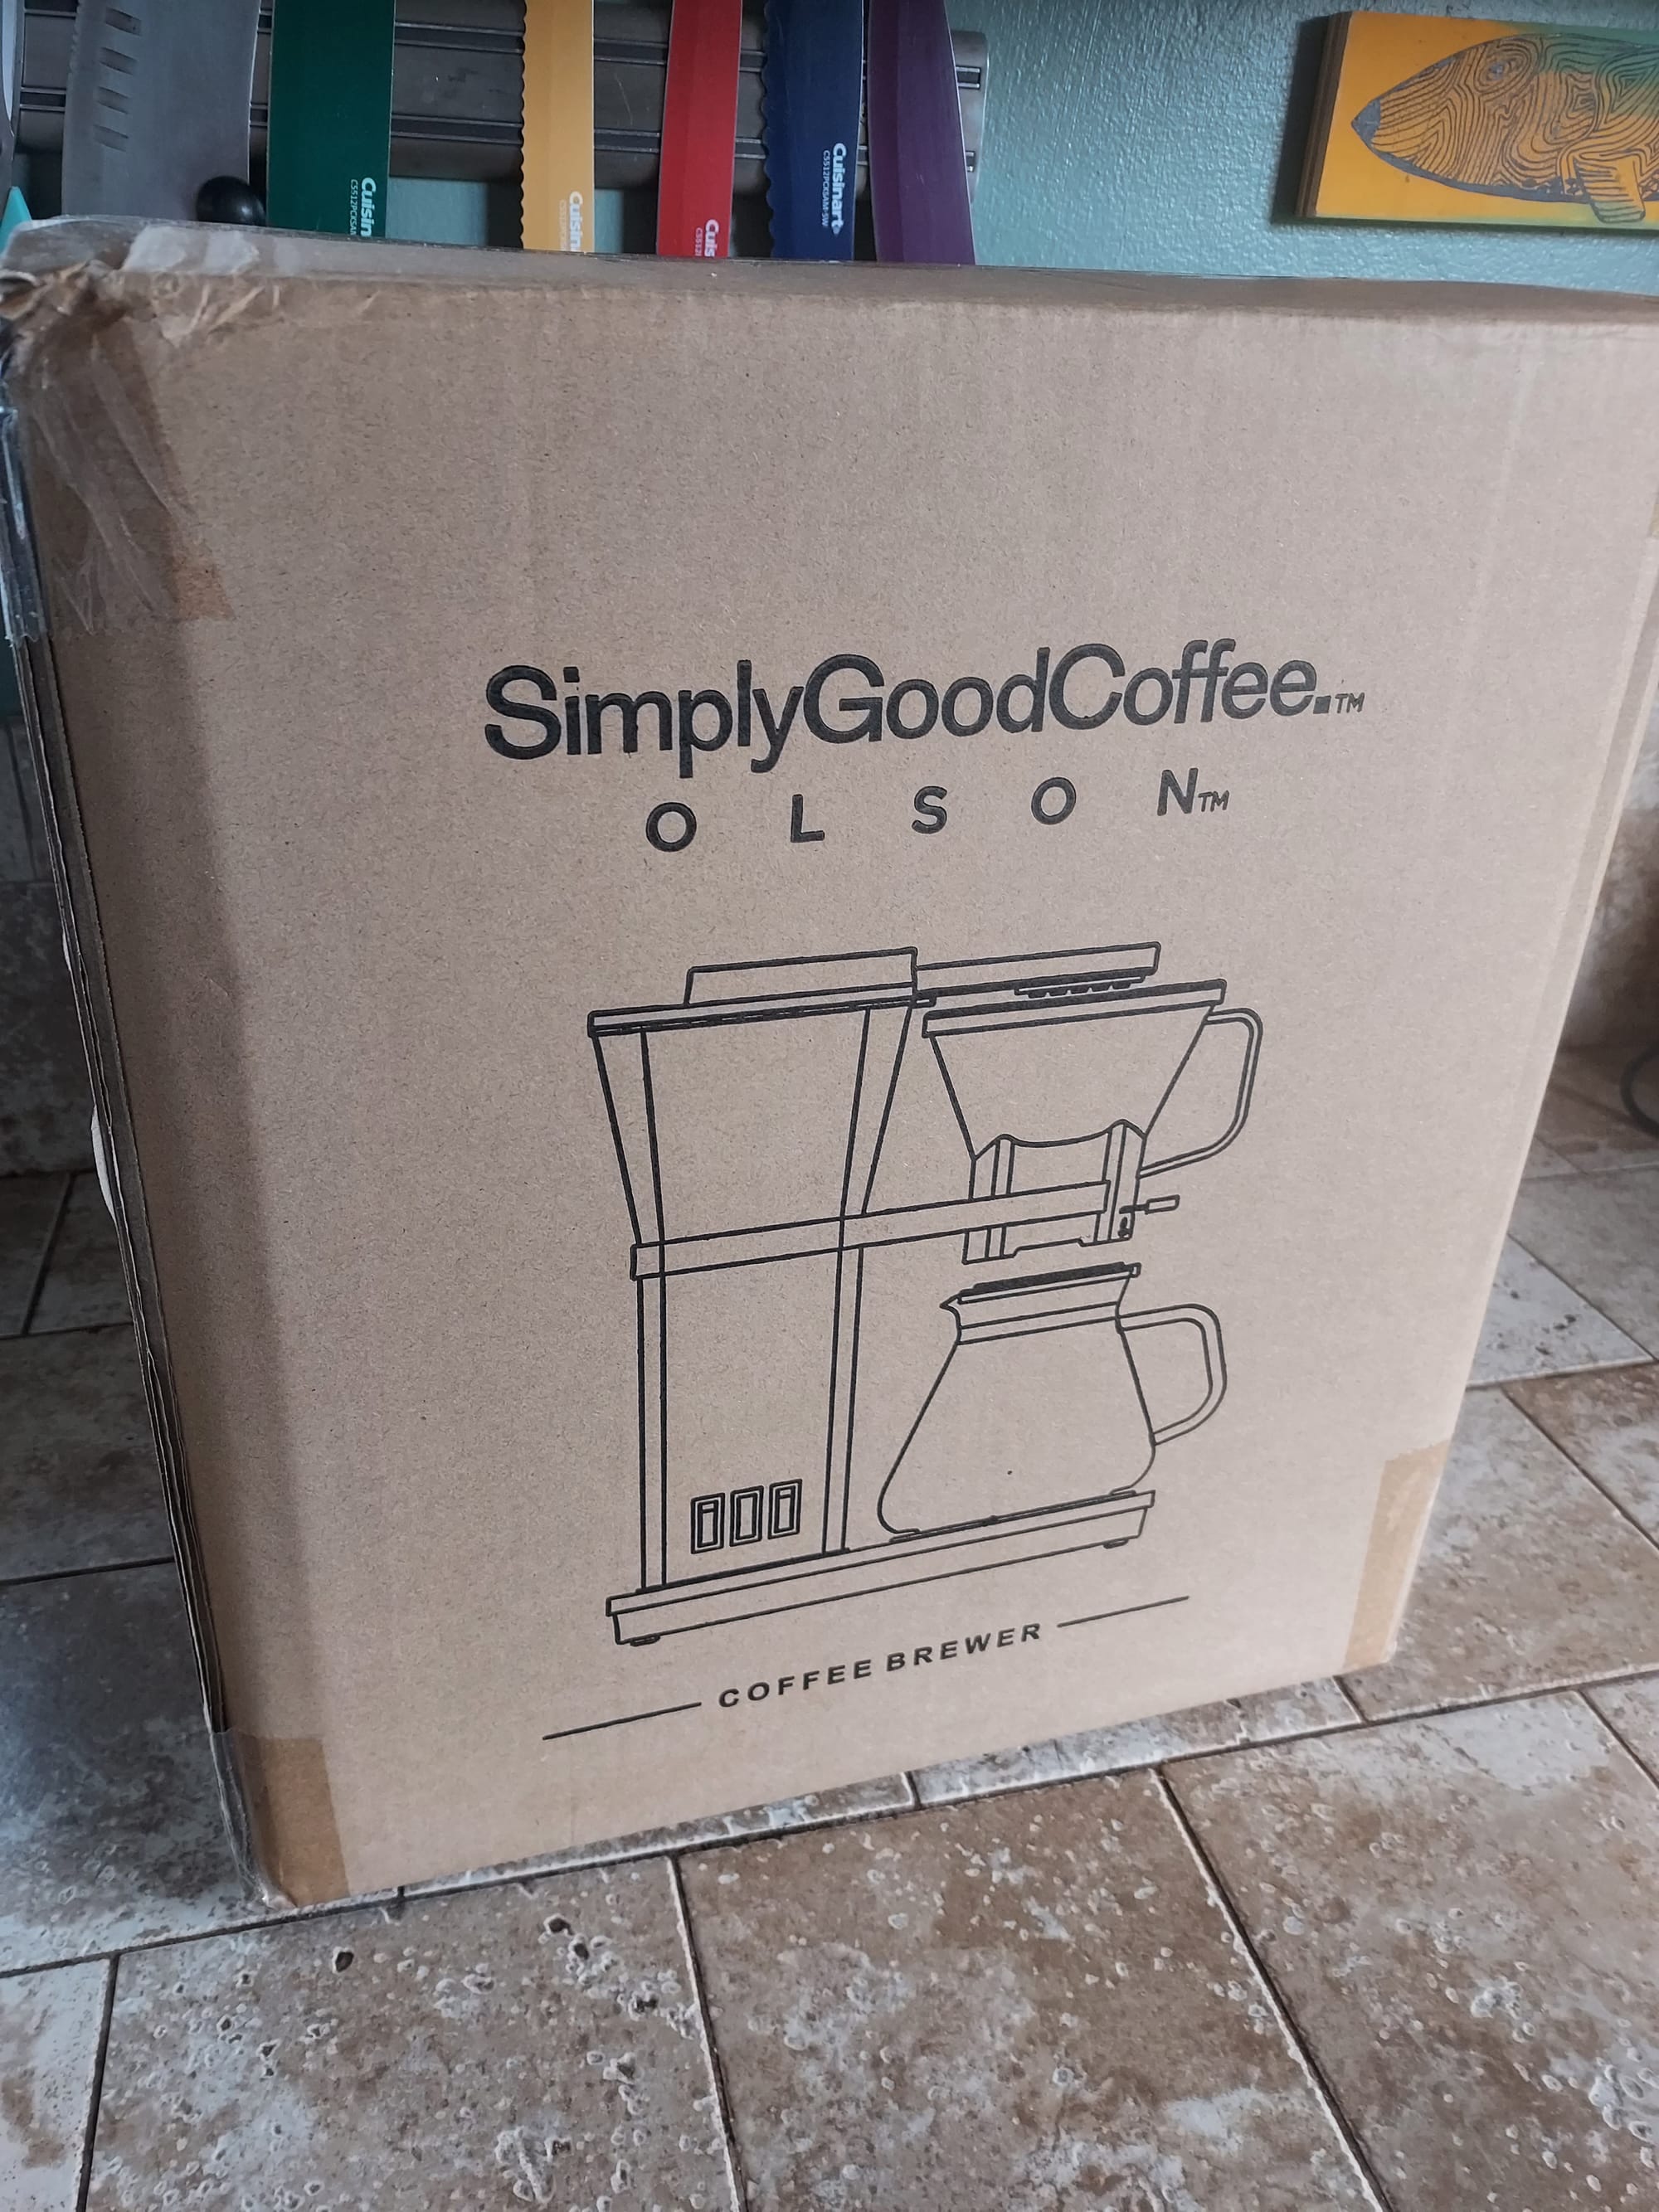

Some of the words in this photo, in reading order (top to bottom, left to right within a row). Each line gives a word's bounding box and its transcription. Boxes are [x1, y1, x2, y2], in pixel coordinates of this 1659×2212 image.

[361, 177, 377, 237] Cuisin
[831, 142, 847, 228] Cuisinart
[718, 1659, 872, 1709] COFFEE
[886, 1622, 1041, 1673] BREWER
